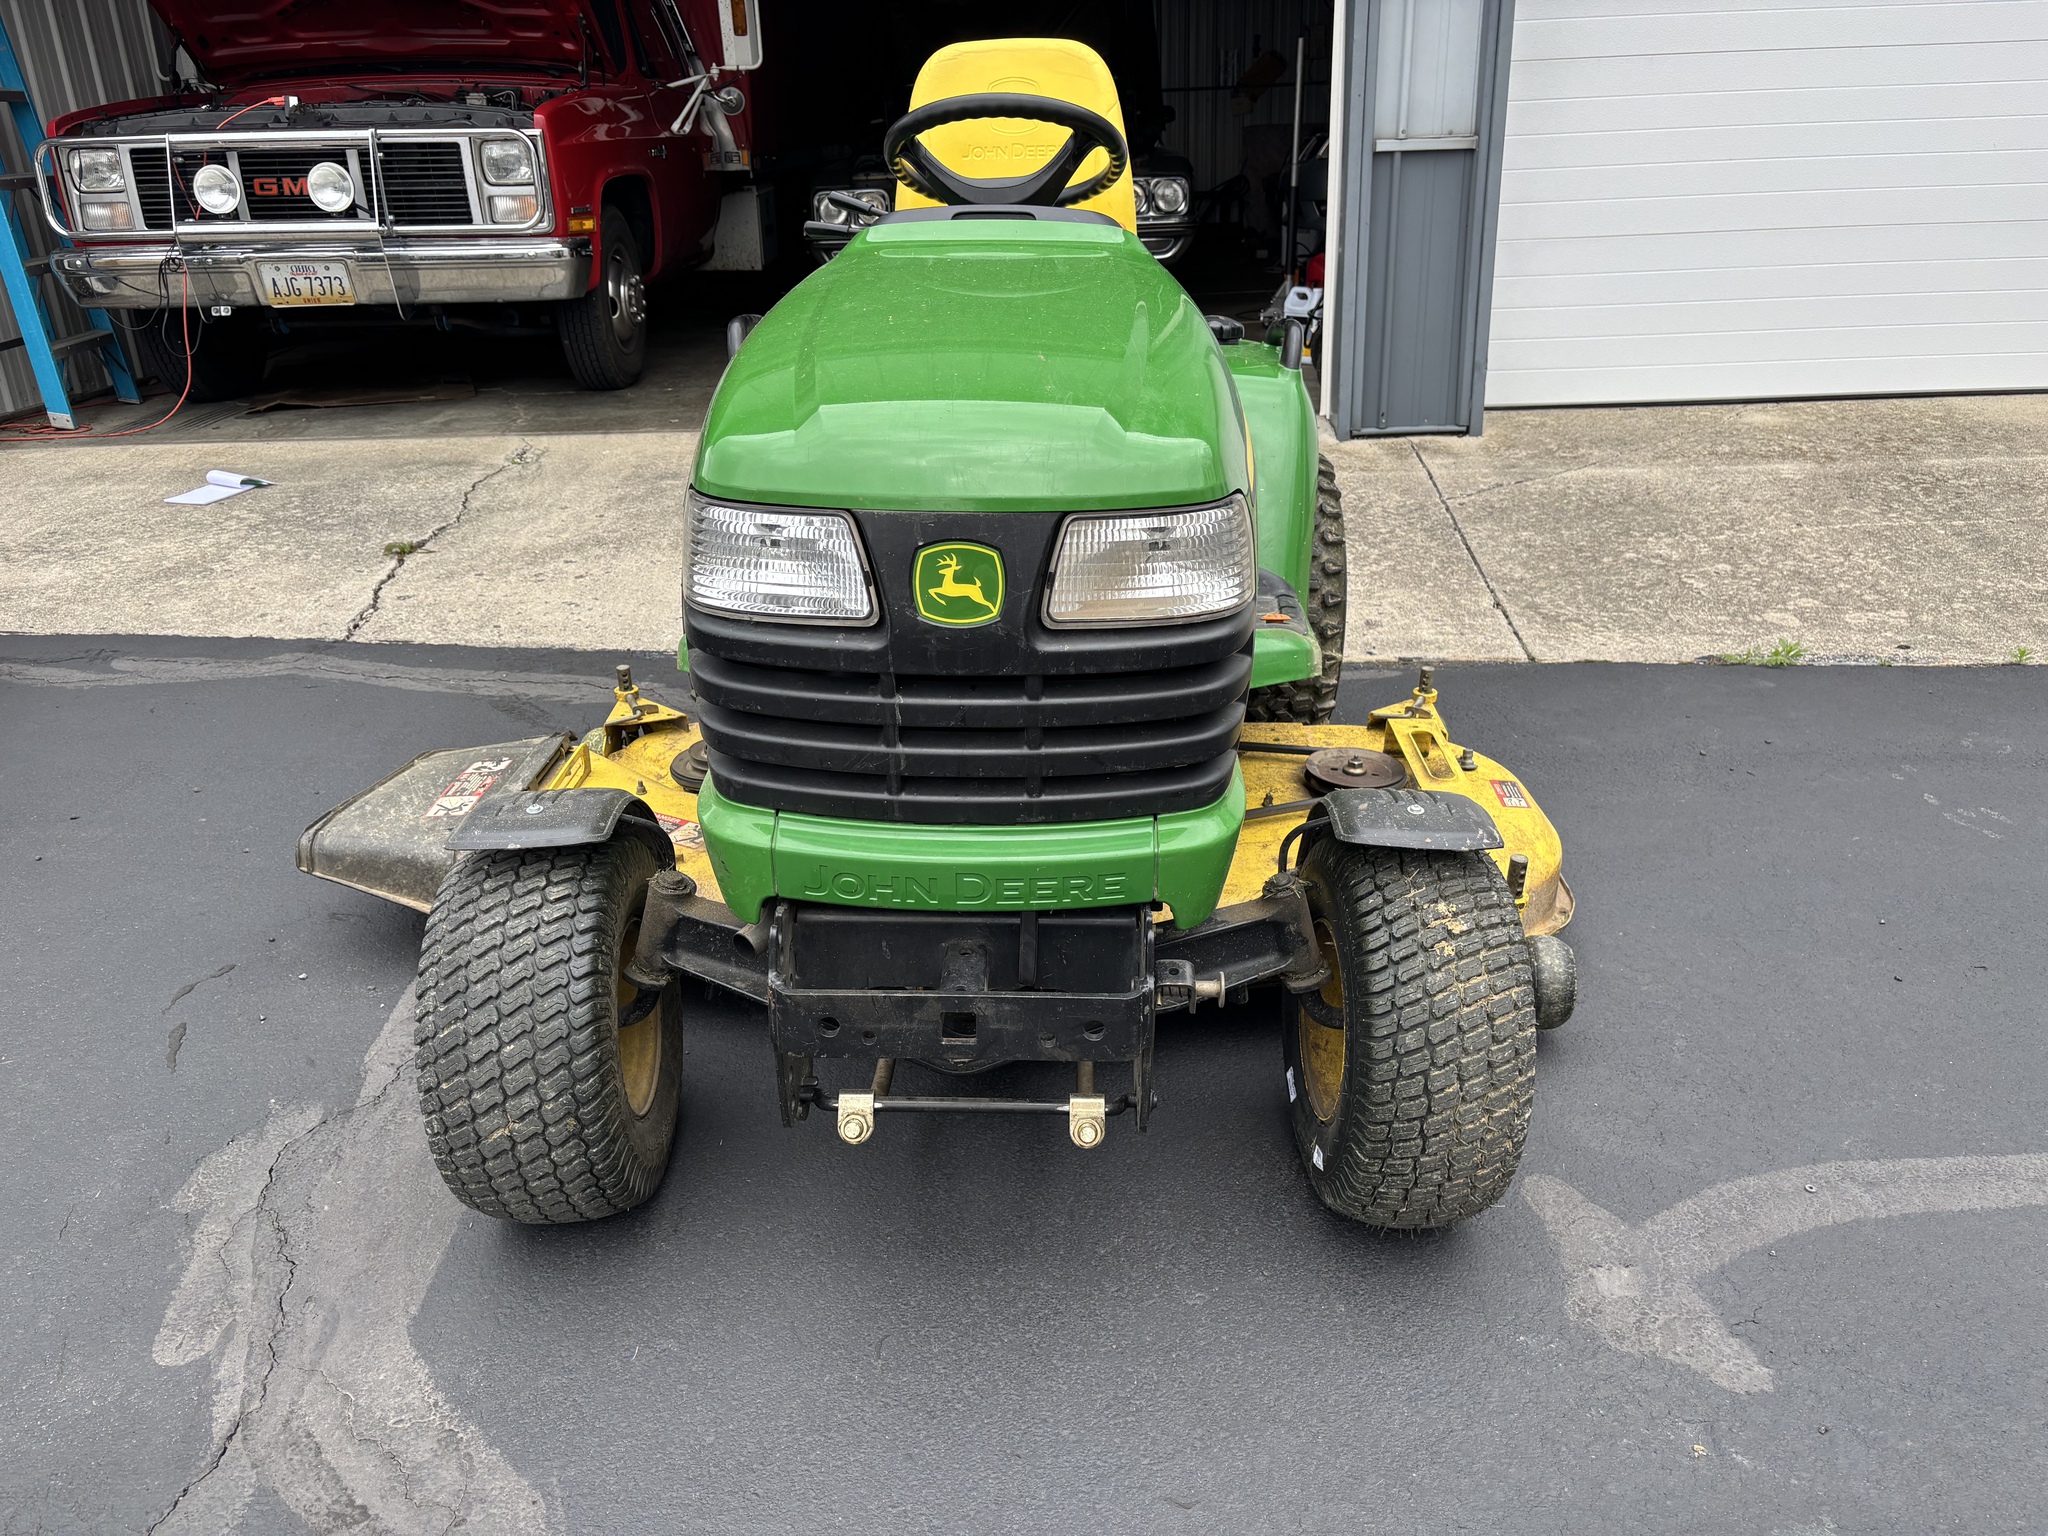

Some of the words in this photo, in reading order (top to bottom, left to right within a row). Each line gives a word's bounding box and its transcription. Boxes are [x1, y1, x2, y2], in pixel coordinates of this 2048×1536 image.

[961, 144, 1008, 161] JOHN
[1011, 143, 1061, 160] DEER
[253, 177, 309, 196] GM
[290, 264, 316, 273] OHIO
[271, 277, 302, 298] AJG
[303, 276, 346, 297] 7373
[804, 864, 939, 905] JOHN
[954, 871, 1127, 905] DEERE
